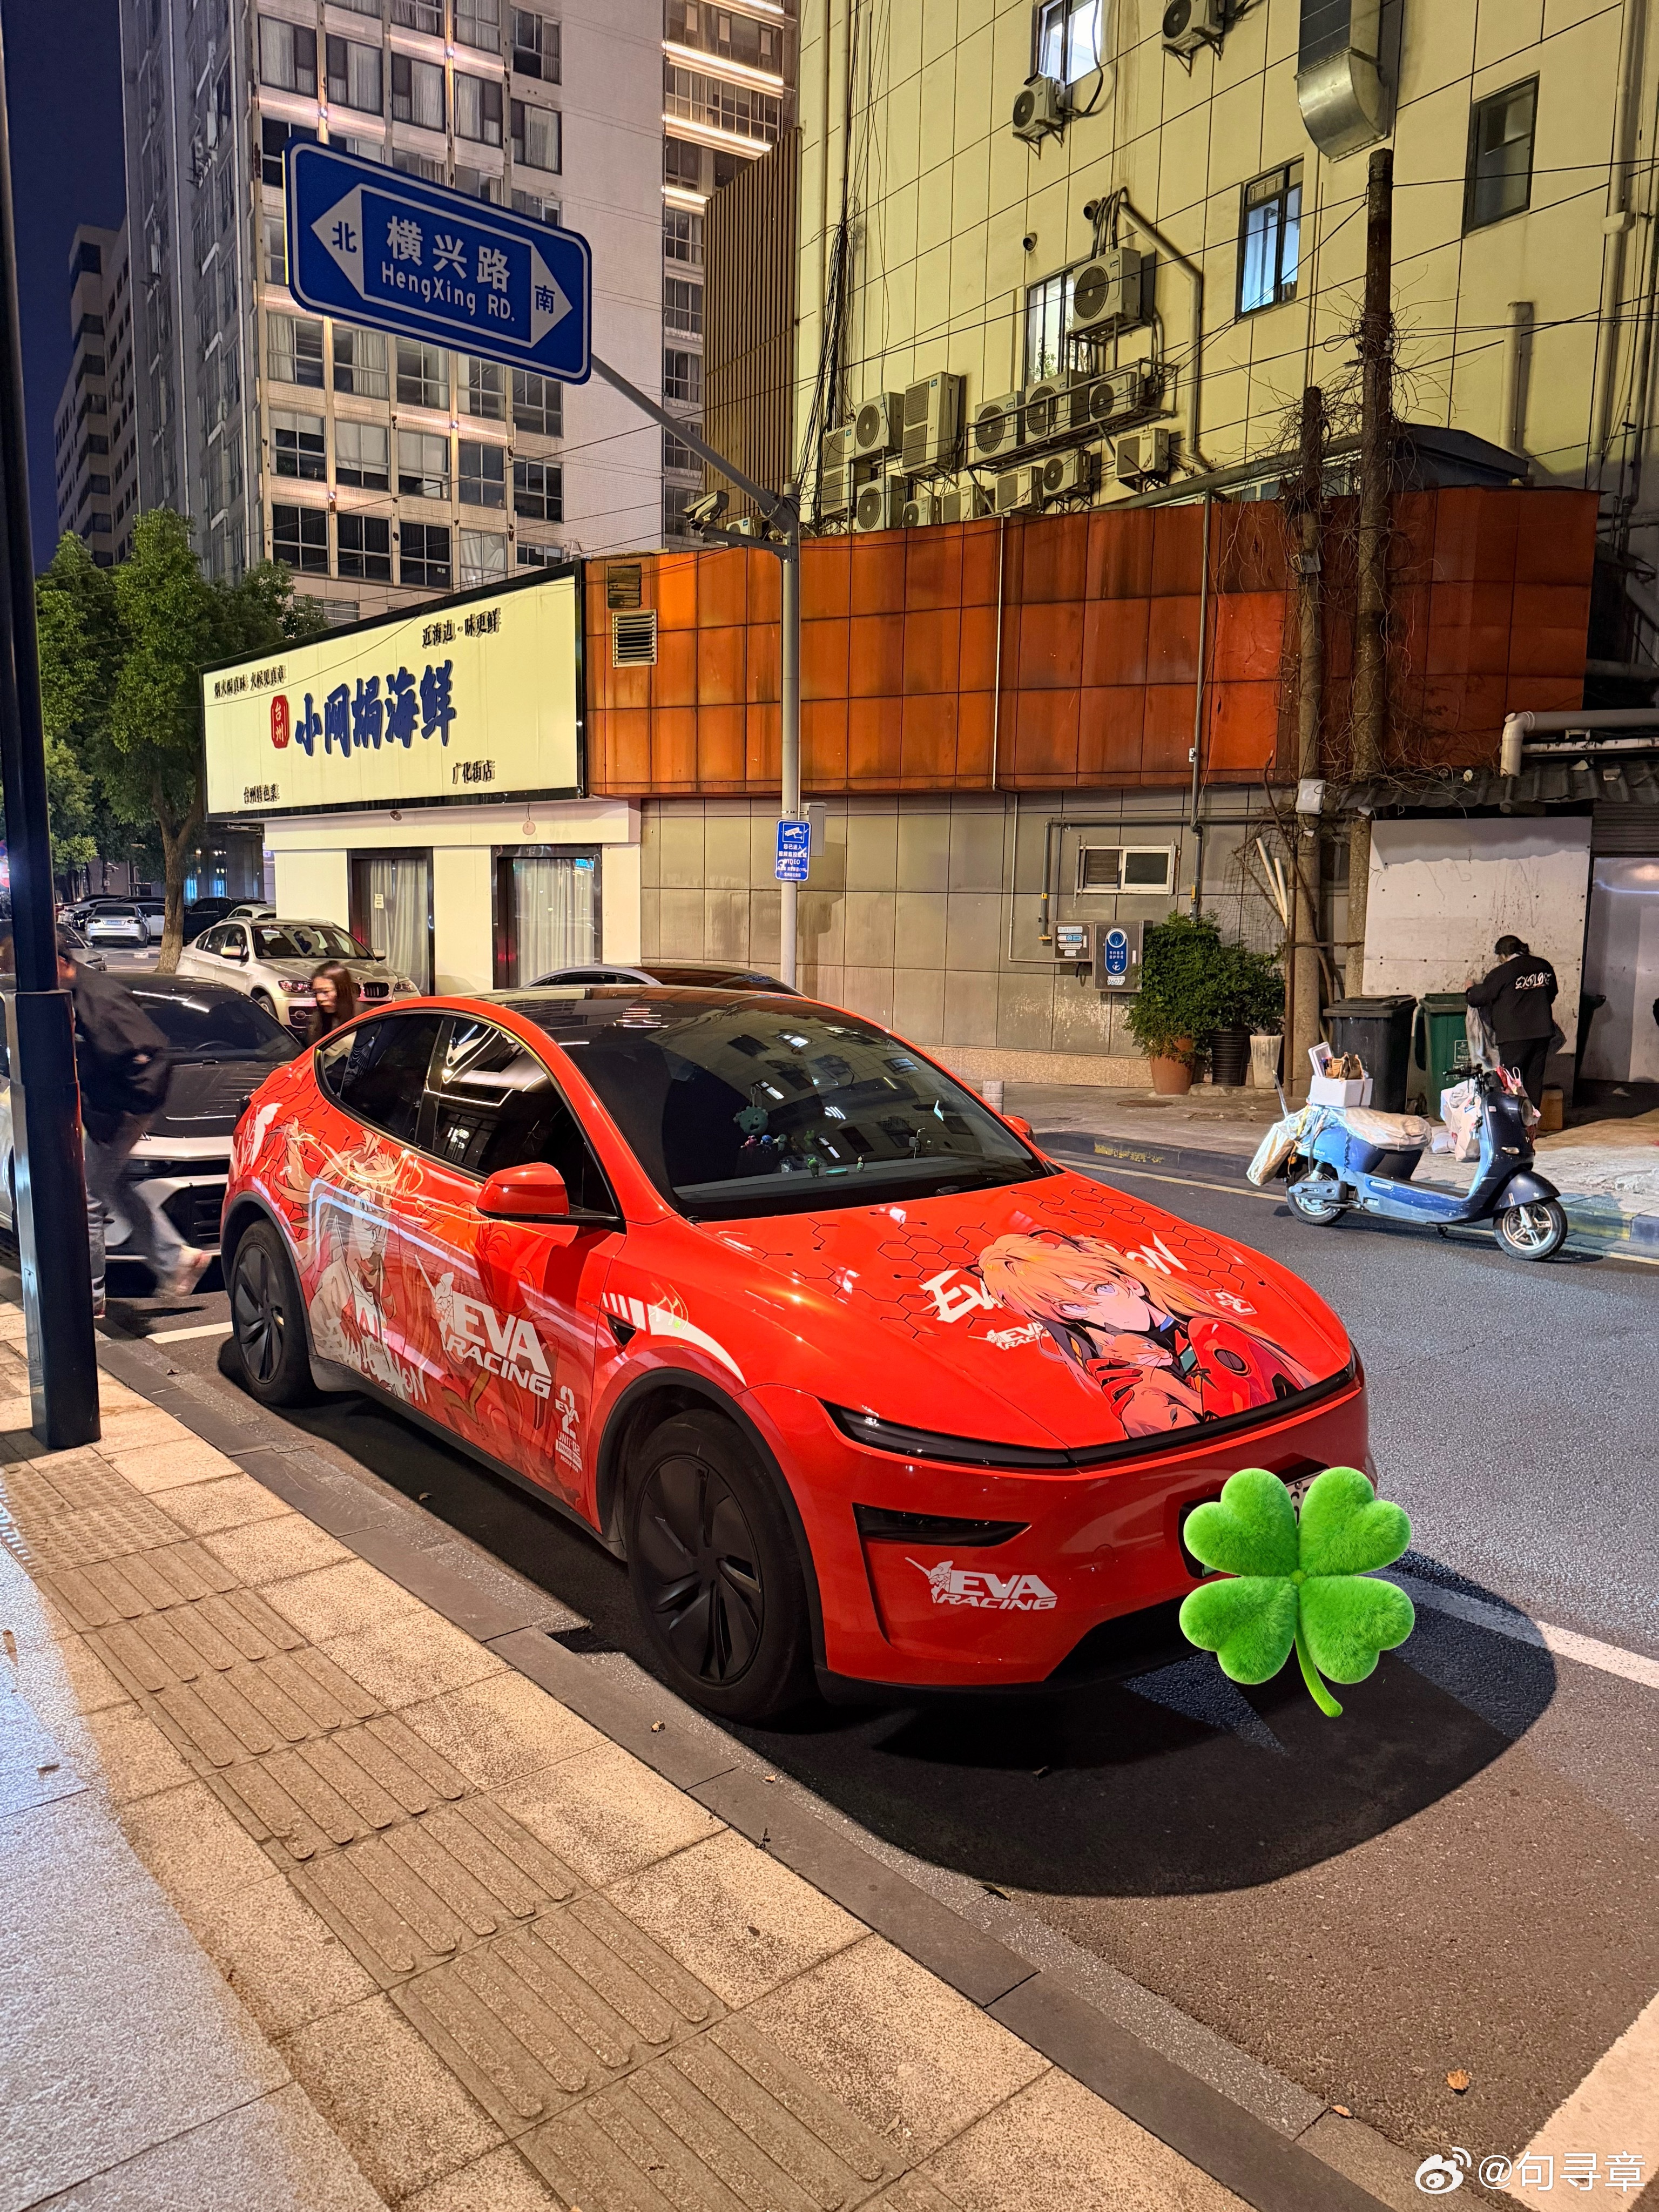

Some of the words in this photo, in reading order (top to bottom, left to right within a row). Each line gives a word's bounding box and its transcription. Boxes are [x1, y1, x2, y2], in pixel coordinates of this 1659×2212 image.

[332, 221, 357, 253] 北
[386, 216, 510, 293] 横兴路
[382, 261, 476, 316] HengXing
[488, 297, 515, 321] RD.
[535, 285, 555, 314] 南
[274, 700, 284, 743] 台州
[452, 760, 495, 784] 广化街店
[452, 1290, 552, 1378] EVA
[446, 1334, 552, 1400] RACING
[936, 1593, 1058, 1610] RACING
[948, 1569, 1057, 1599] EVA
